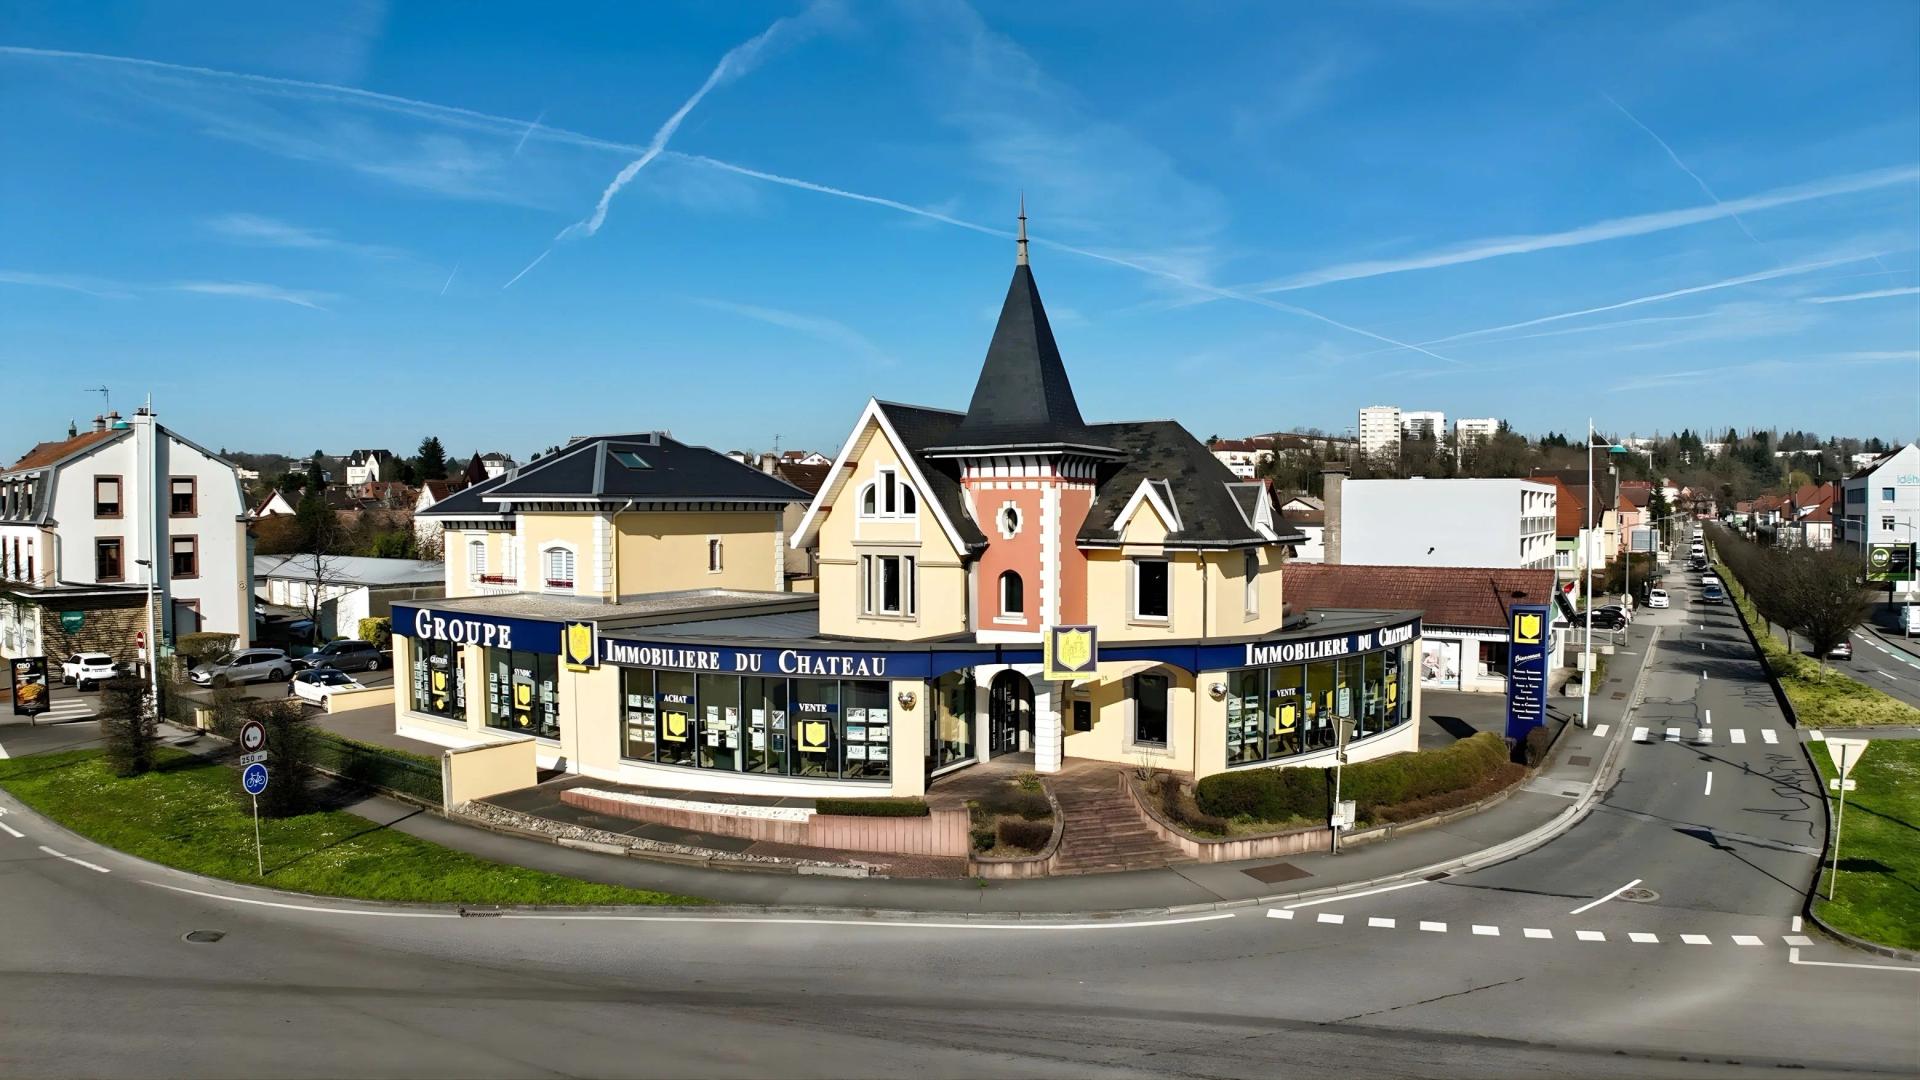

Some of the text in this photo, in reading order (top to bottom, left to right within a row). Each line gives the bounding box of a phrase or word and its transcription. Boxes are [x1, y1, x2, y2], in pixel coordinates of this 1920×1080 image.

[415, 609, 512, 649] GROUPE
[1244, 638, 1349, 666] IMMOBILIERE
[1358, 634, 1372, 651] DU
[605, 639, 887, 676] IMMOBILIERE DU CHATEAU
[1276, 687, 1297, 698] VENTE
[663, 694, 688, 704] ACHAT
[798, 702, 828, 713] VENTE
[242, 755, 255, 764] 250
